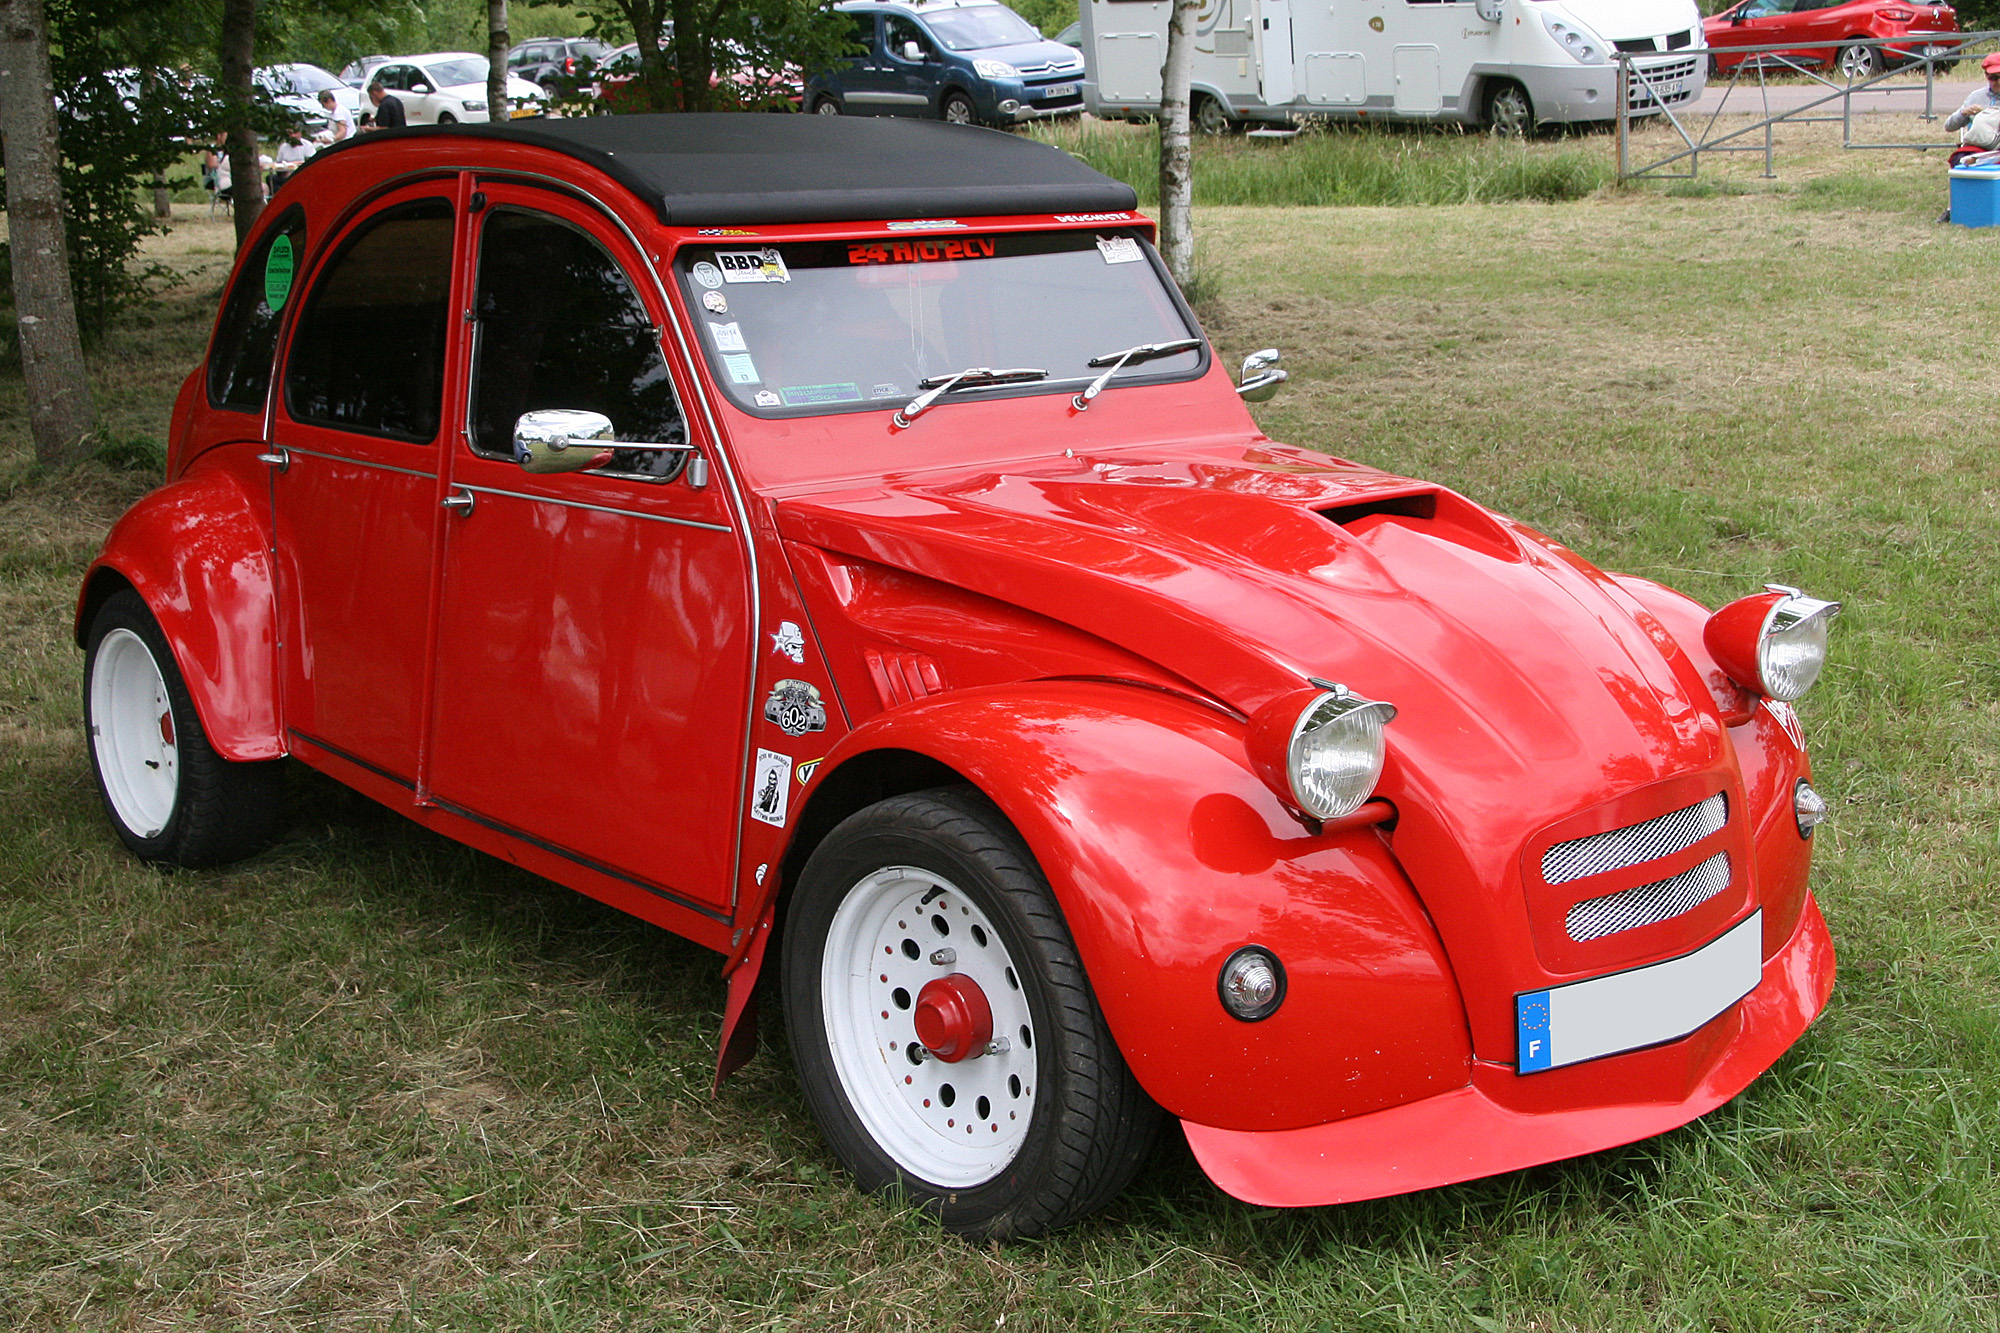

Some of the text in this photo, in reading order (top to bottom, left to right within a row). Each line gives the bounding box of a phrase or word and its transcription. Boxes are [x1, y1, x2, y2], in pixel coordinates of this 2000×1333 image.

[847, 243, 888, 263] 24
[943, 239, 996, 259] 2CV
[720, 255, 763, 270] BBD
[781, 707, 806, 730] 602
[1529, 1039, 1542, 1058] F
